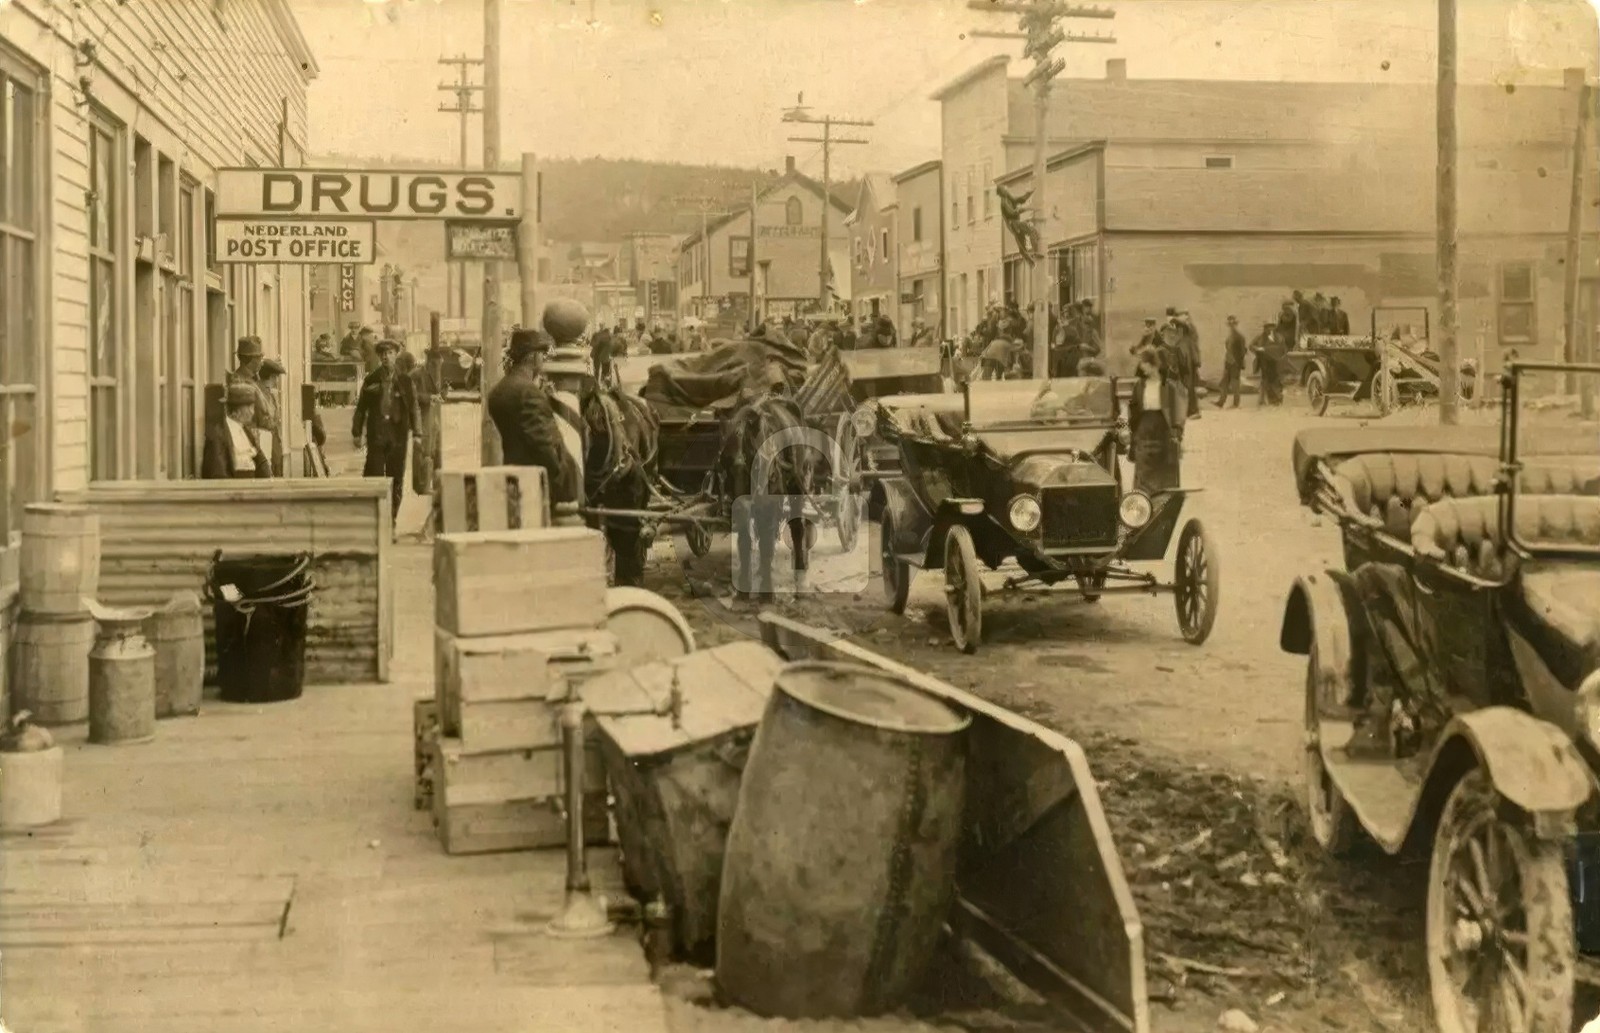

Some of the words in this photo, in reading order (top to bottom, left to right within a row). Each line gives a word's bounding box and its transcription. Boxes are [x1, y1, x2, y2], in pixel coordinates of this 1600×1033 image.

[263, 174, 514, 215] DRUGS.
[244, 224, 348, 236] NEDERLAND
[227, 239, 282, 256] POST
[289, 239, 361, 257] OFFICE
[342, 263, 354, 310] UNCH
